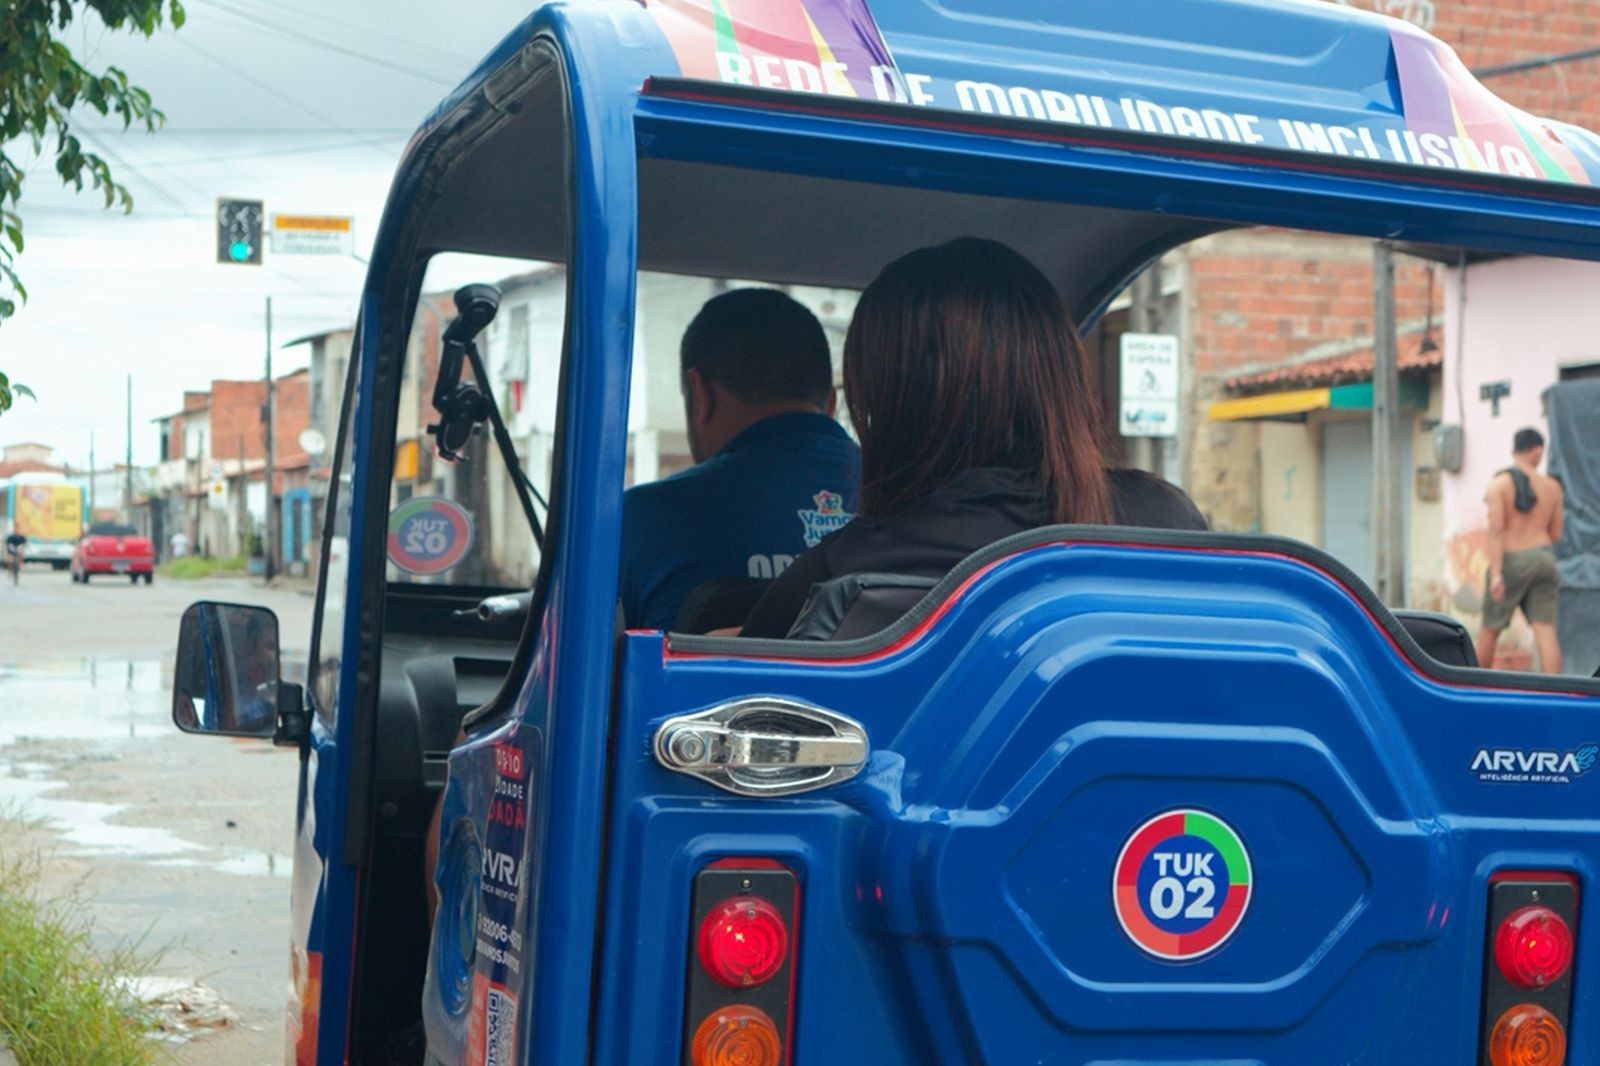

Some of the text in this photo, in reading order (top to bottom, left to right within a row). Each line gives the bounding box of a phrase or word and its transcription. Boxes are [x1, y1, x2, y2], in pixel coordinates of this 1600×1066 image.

[715, 52, 1537, 178] REDE DE MOBILIDADE INCLUSIVA
[1471, 750, 1580, 773] ARVRA
[1153, 853, 1214, 877] TUK
[1150, 877, 1216, 920] 02
